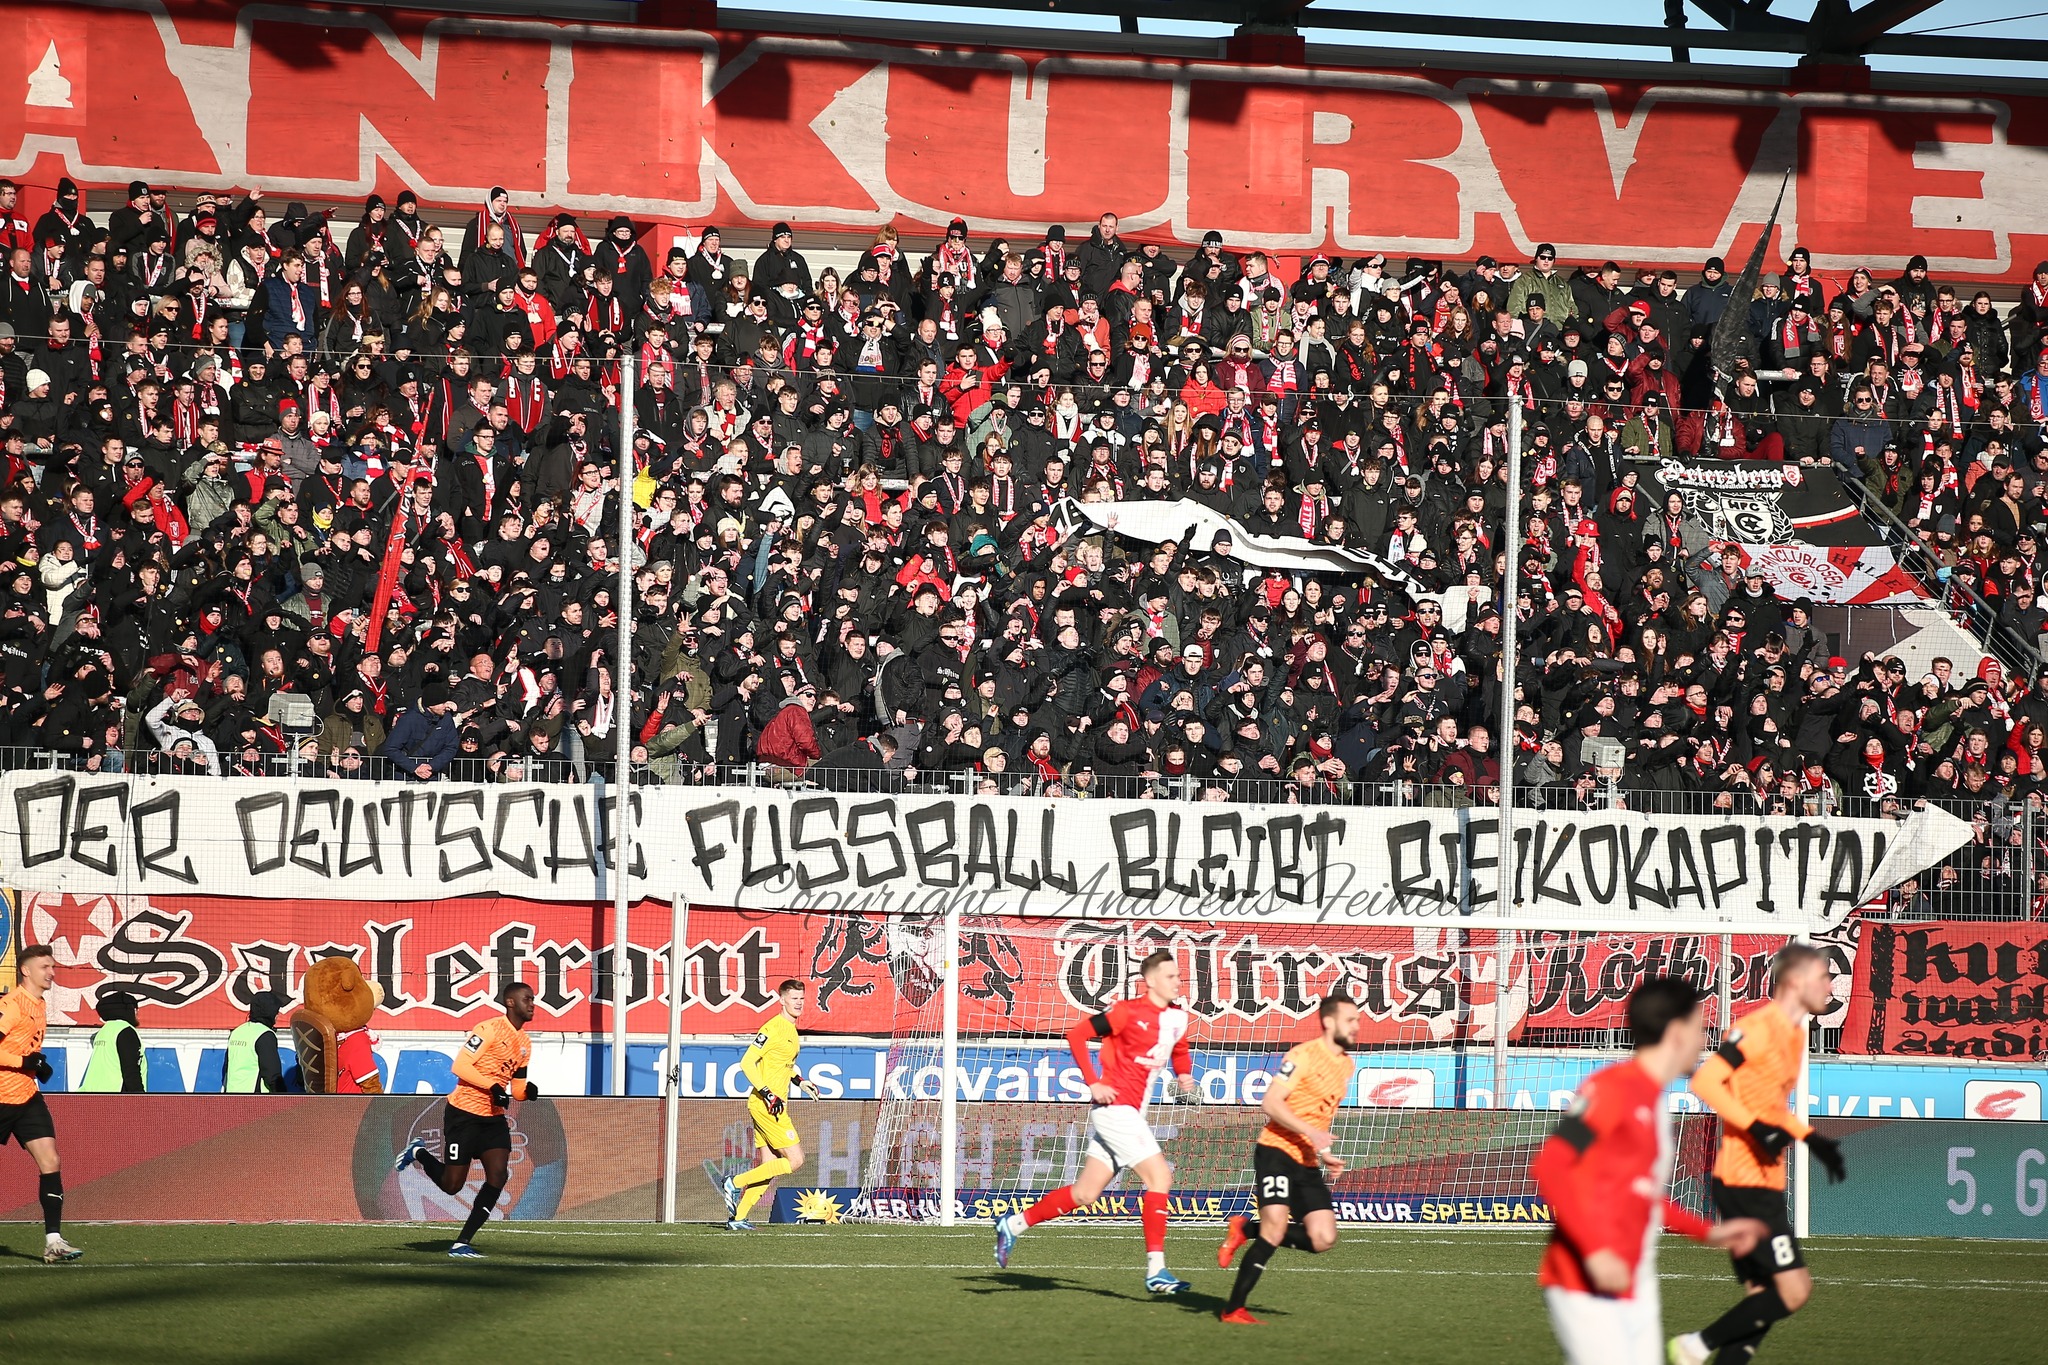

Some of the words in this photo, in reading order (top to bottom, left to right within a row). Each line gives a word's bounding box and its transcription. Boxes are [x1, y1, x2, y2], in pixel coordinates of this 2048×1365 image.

[1728, 501, 1760, 511] HFC
[15, 776, 199, 885] DER
[236, 788, 648, 884] DEUTSCHE
[686, 797, 1077, 893] FUSSBALL
[1110, 808, 1347, 908] BLEIBT
[95, 909, 776, 1011] Salefront
[449, 1143, 459, 1161] 9
[1262, 1175, 1289, 1199] 29
[1947, 1146, 1993, 1216] 5.
[849, 1198, 968, 1220] MERKUR
[974, 1196, 1130, 1219] SPIEANK
[1139, 1197, 1224, 1216] ALLE
[1331, 1201, 1414, 1222] ERKUR
[1771, 1235, 1796, 1267] 8
